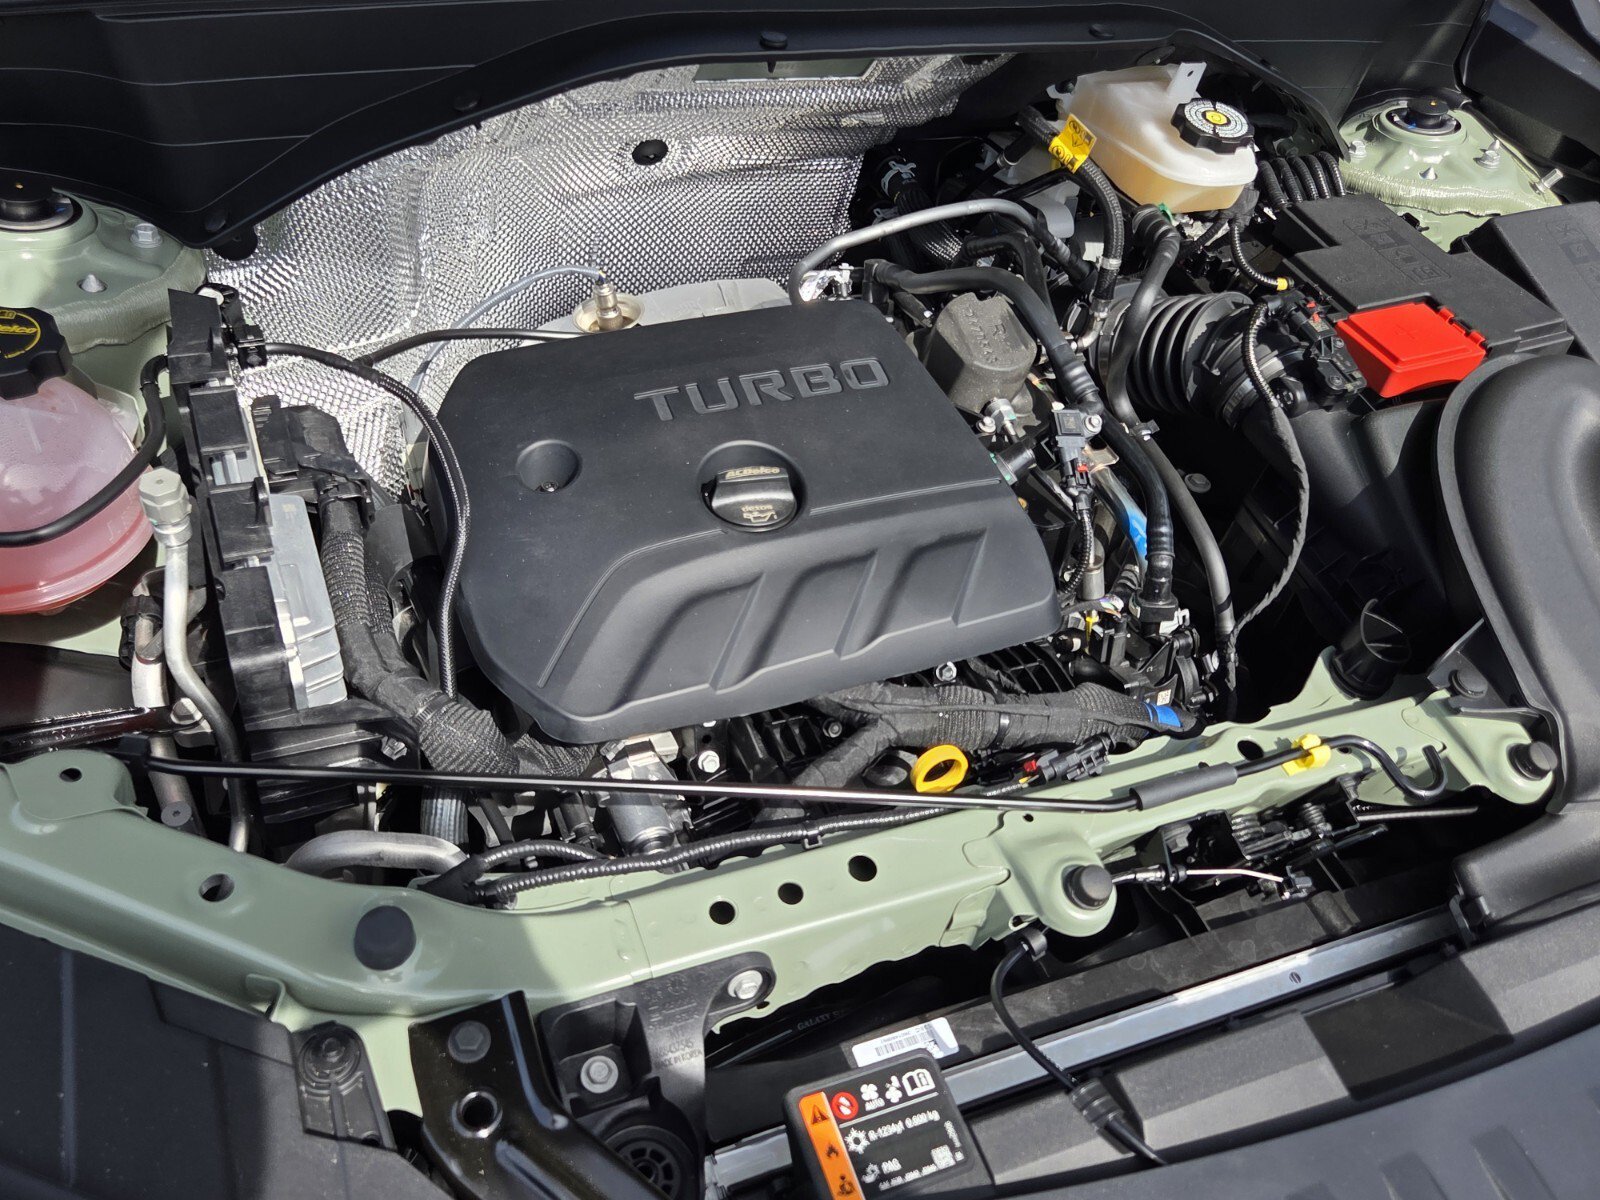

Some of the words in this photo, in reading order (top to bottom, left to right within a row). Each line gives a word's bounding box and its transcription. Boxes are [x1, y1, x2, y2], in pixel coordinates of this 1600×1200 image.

[0, 324, 38, 335] elco
[634, 357, 889, 421] TURBO
[726, 465, 780, 480] ACDelco
[741, 504, 773, 512] dexos
[865, 1098, 885, 1112] AUTO
[881, 1158, 902, 1174] PAG
